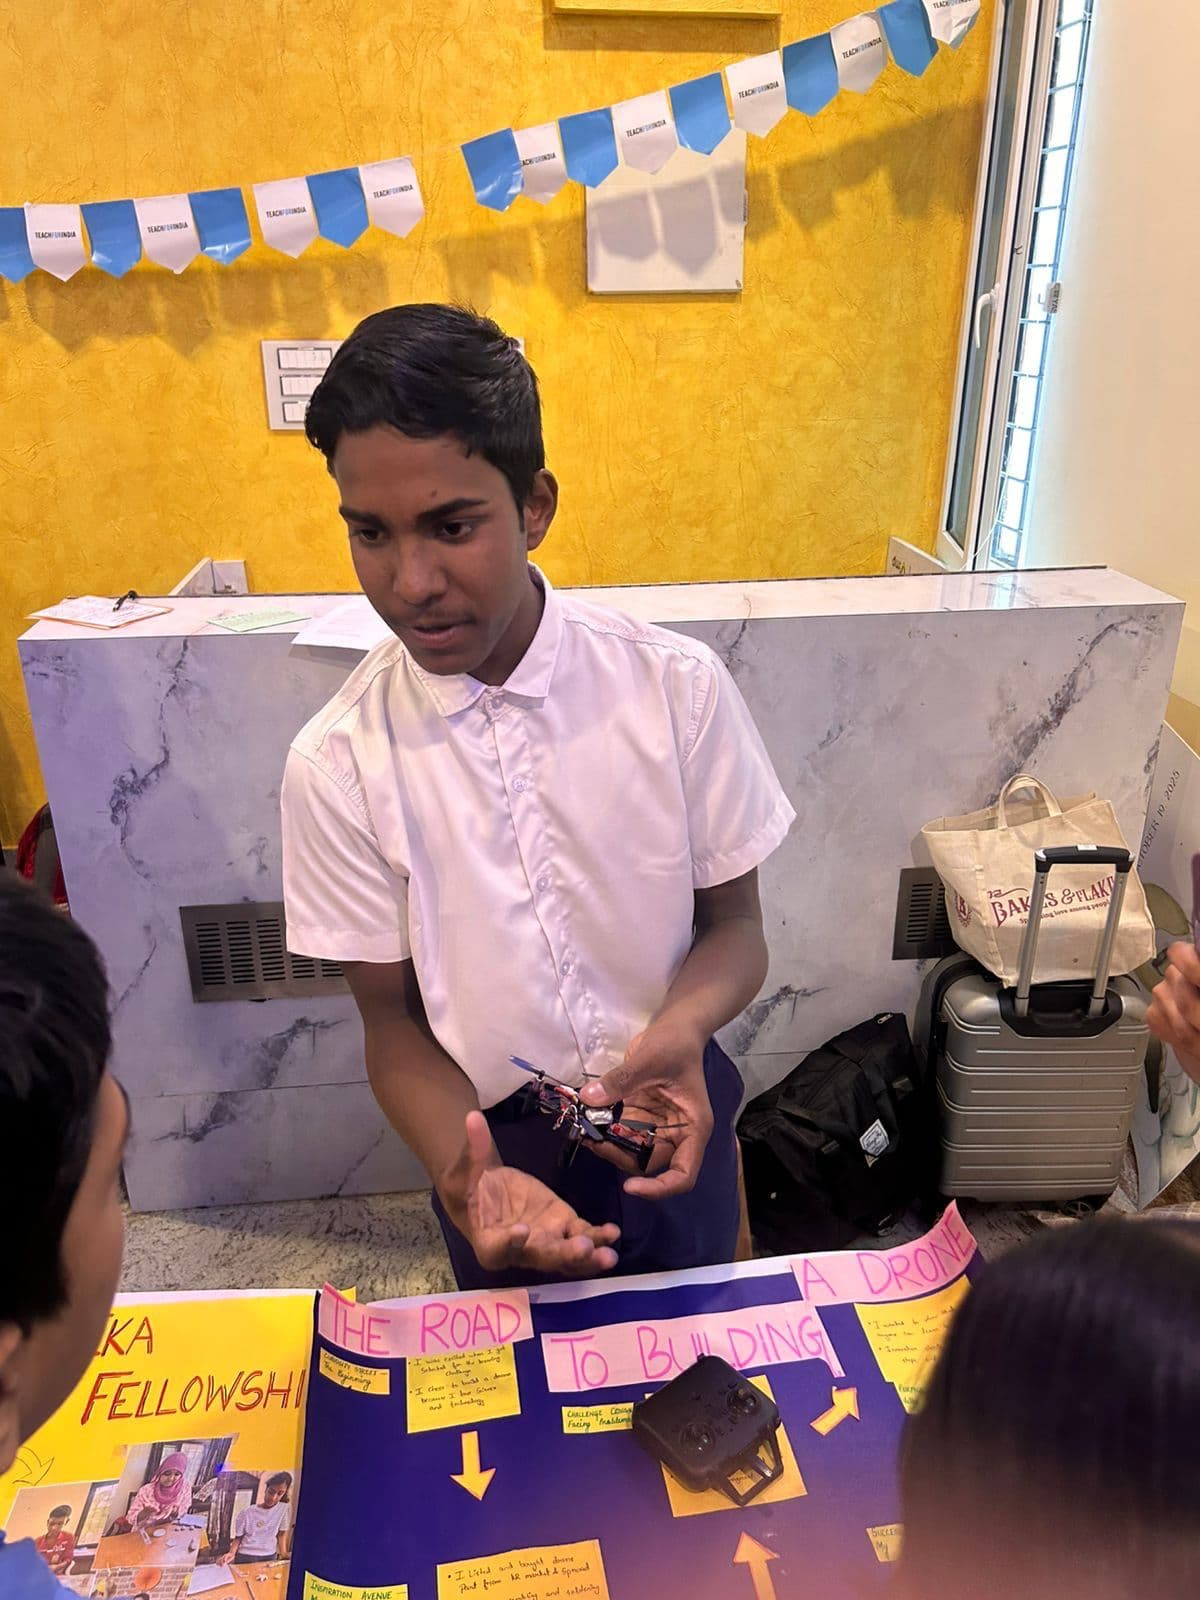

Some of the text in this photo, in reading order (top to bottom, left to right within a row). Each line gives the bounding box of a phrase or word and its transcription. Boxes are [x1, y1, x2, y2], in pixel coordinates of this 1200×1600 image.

[522, 152, 557, 167] ACHFORINDIA
[1164, 770, 1180, 800] 2025
[991, 892, 1058, 928] BAKS
[1091, 900, 1111, 911] peopl
[803, 1209, 974, 1300] A DRONE
[96, 1313, 153, 1357] KA
[324, 1282, 521, 1355] THE ROAD
